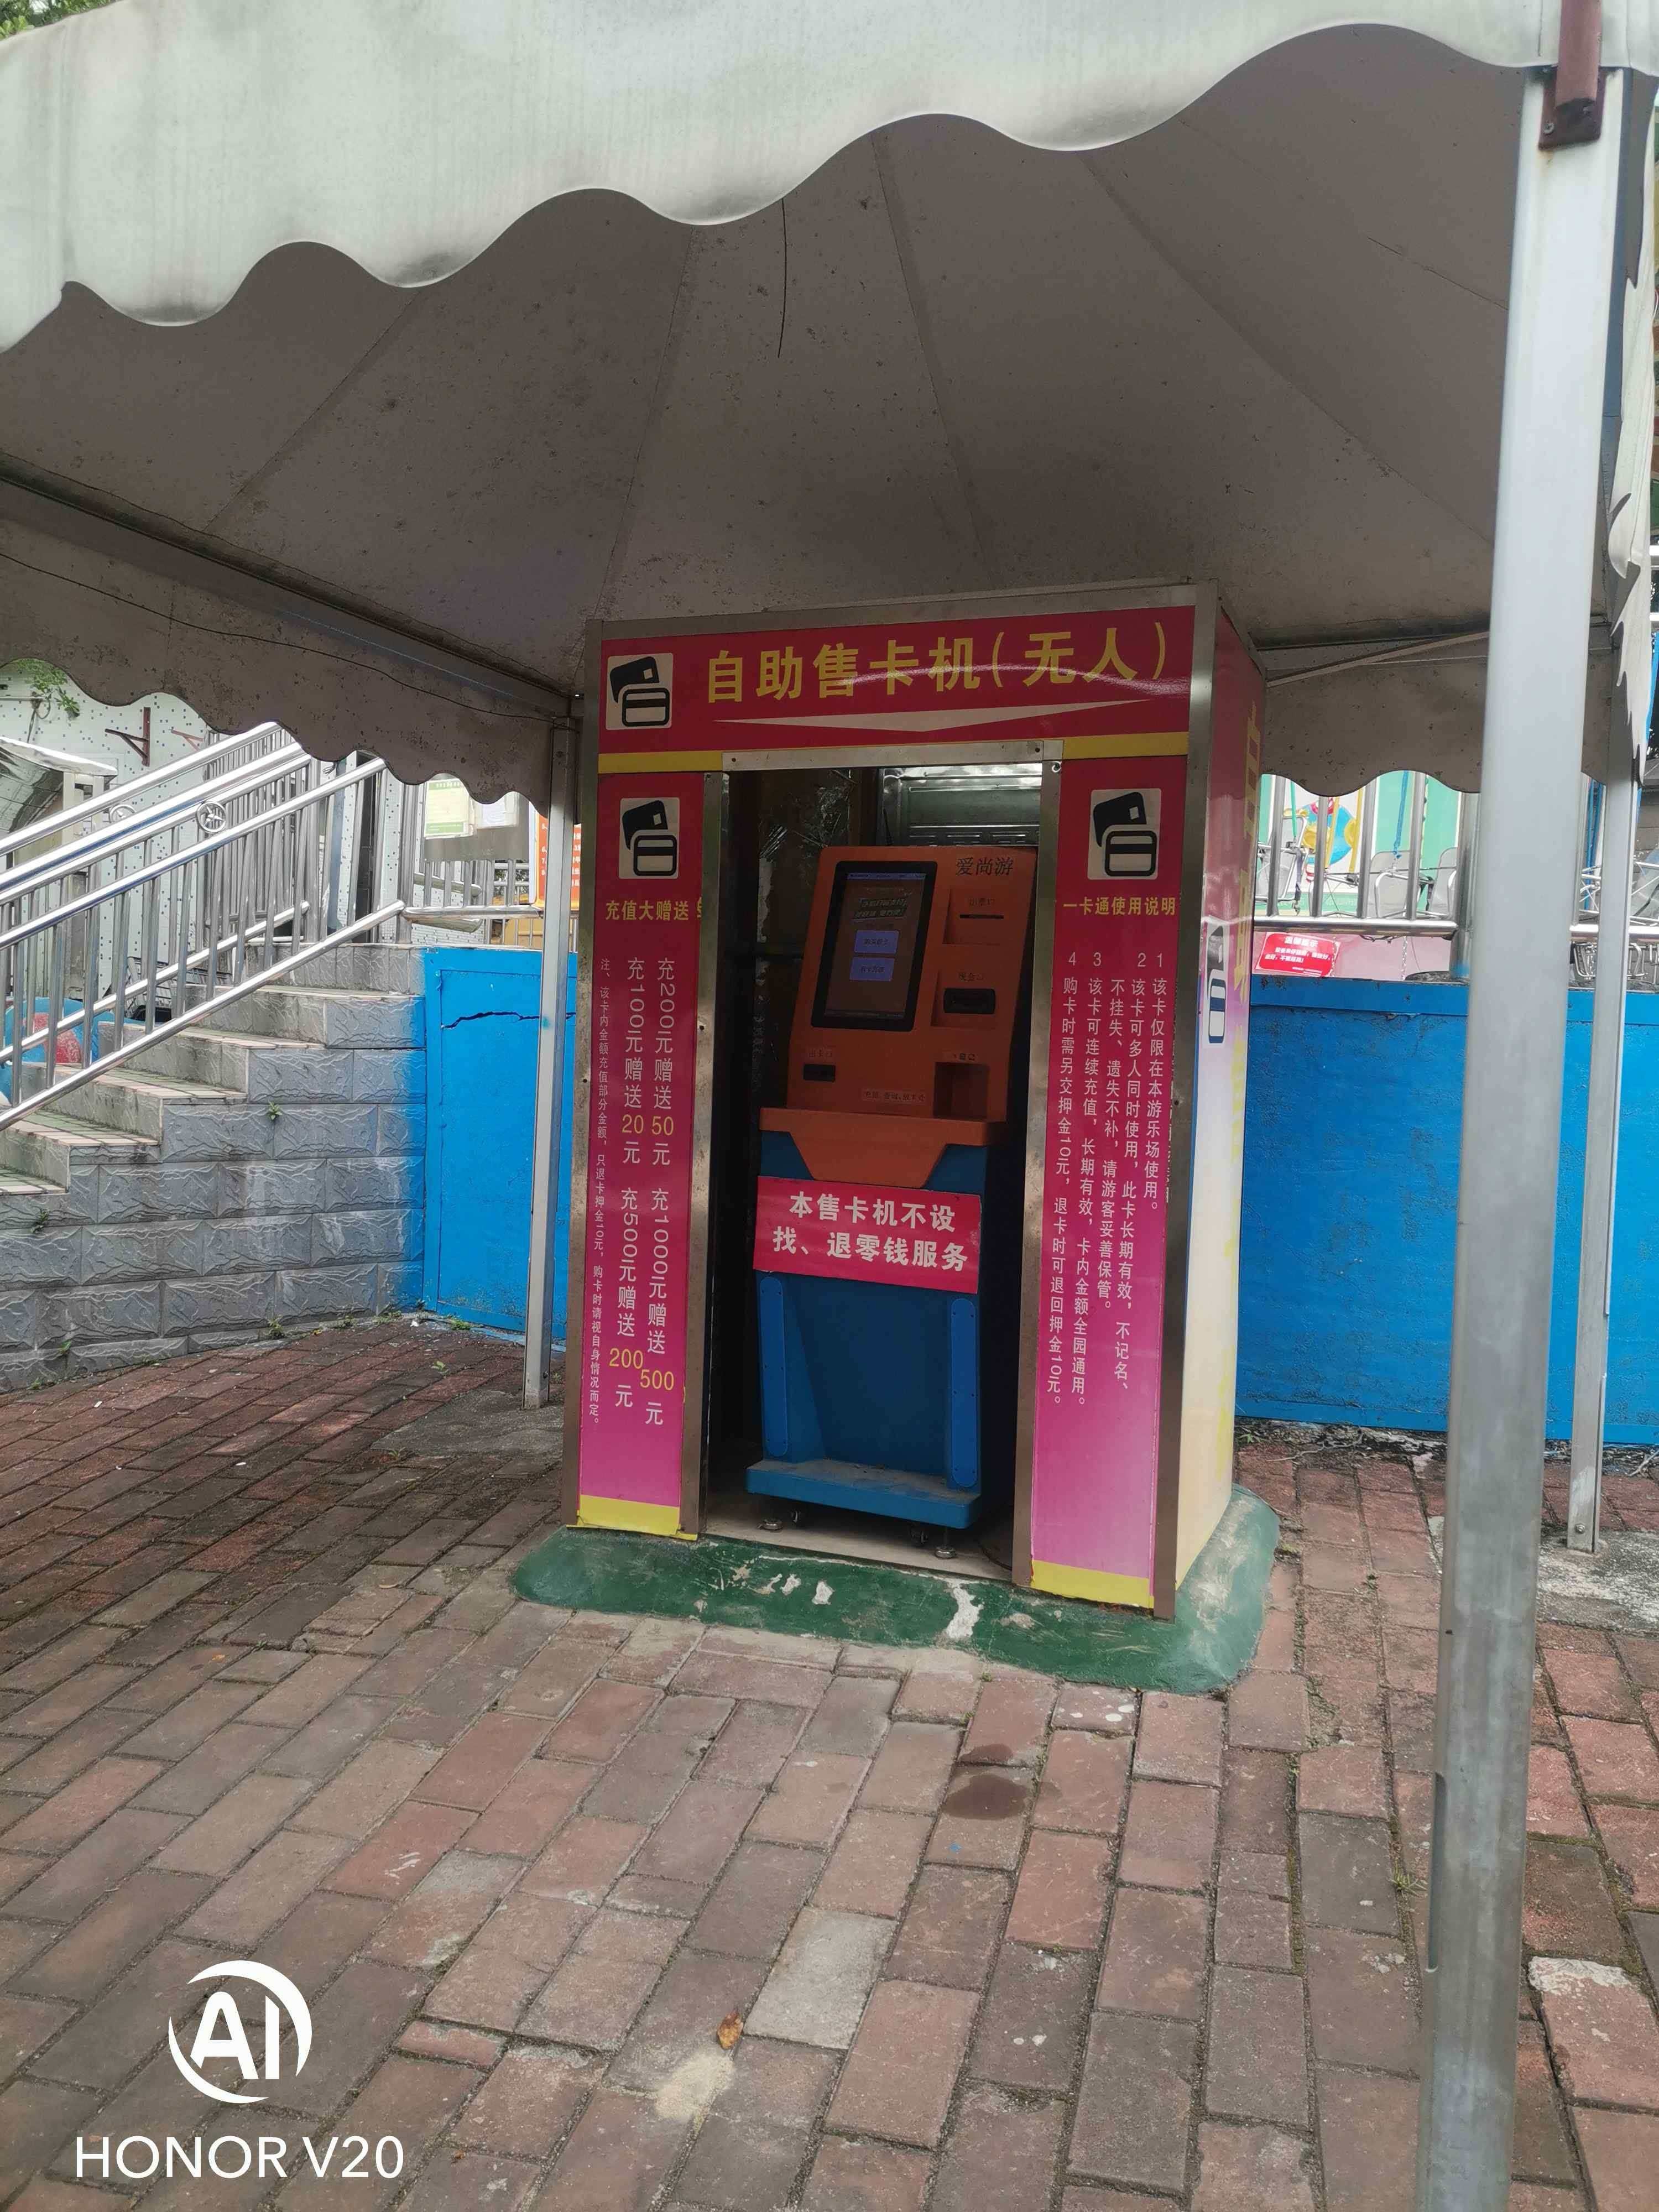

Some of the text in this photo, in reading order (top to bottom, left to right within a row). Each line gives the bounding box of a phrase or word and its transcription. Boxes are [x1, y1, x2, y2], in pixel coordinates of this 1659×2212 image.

[957, 857, 1014, 877] 爱尚游
[606, 900, 689, 921] 充值大赠送
[1062, 896, 1176, 916] 一卡通使用说明
[789, 1191, 956, 1233] 本售卡机不设
[773, 1225, 968, 1272] 找、退零钱服务
